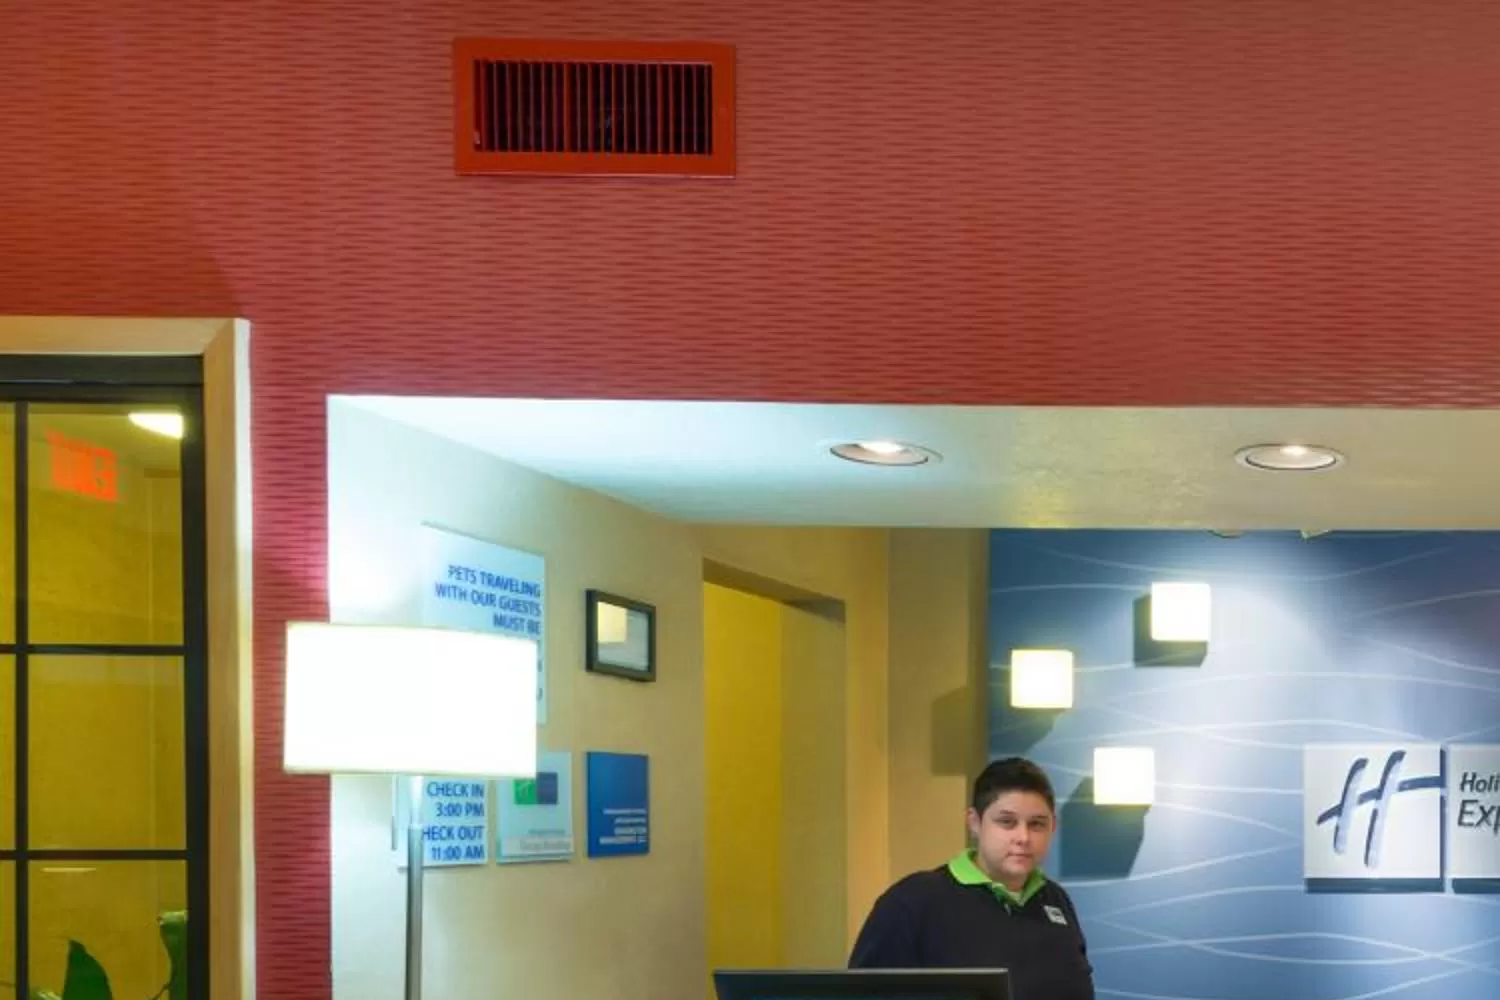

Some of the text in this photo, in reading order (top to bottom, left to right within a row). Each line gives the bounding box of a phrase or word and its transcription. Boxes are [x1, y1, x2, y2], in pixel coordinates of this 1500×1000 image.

[447, 564, 541, 598] PETS TRAVELING
[434, 581, 541, 617] WITH OUR GUESTS
[493, 613, 541, 636] MUST BE
[426, 781, 485, 797] CHECK IN
[435, 802, 485, 817] 3:00 PM
[422, 825, 485, 840] HECK OUT
[431, 844, 485, 860] 11:00 AM
